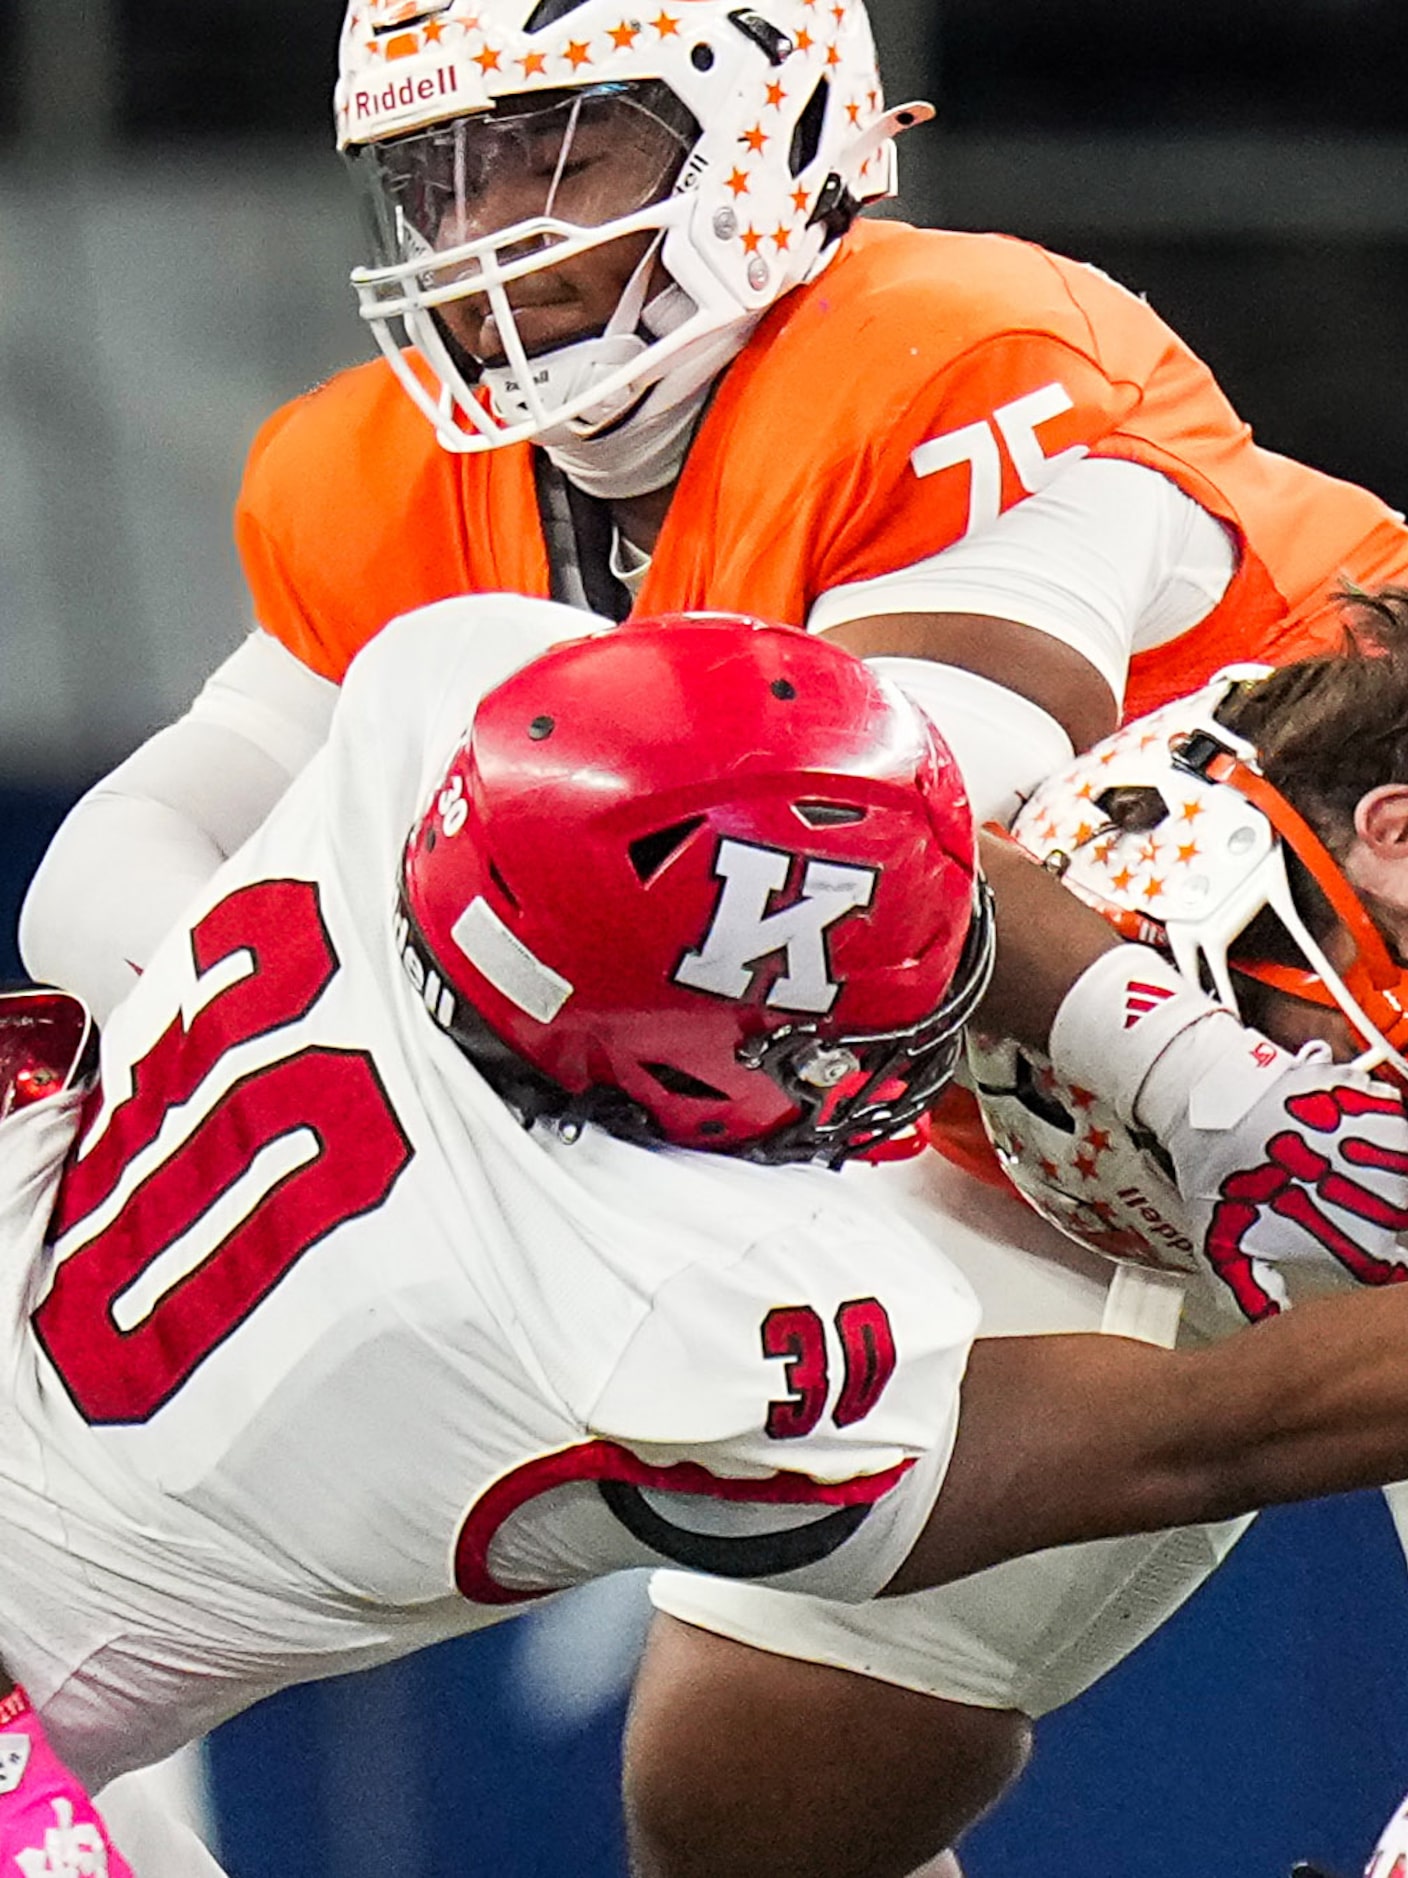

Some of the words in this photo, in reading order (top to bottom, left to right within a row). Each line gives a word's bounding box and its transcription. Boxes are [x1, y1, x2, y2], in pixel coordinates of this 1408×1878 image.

[355, 64, 457, 119] Riddell
[911, 381, 1091, 539] 75
[437, 775, 468, 838] 30
[671, 835, 879, 1015] K
[760, 1296, 897, 1440] 30
